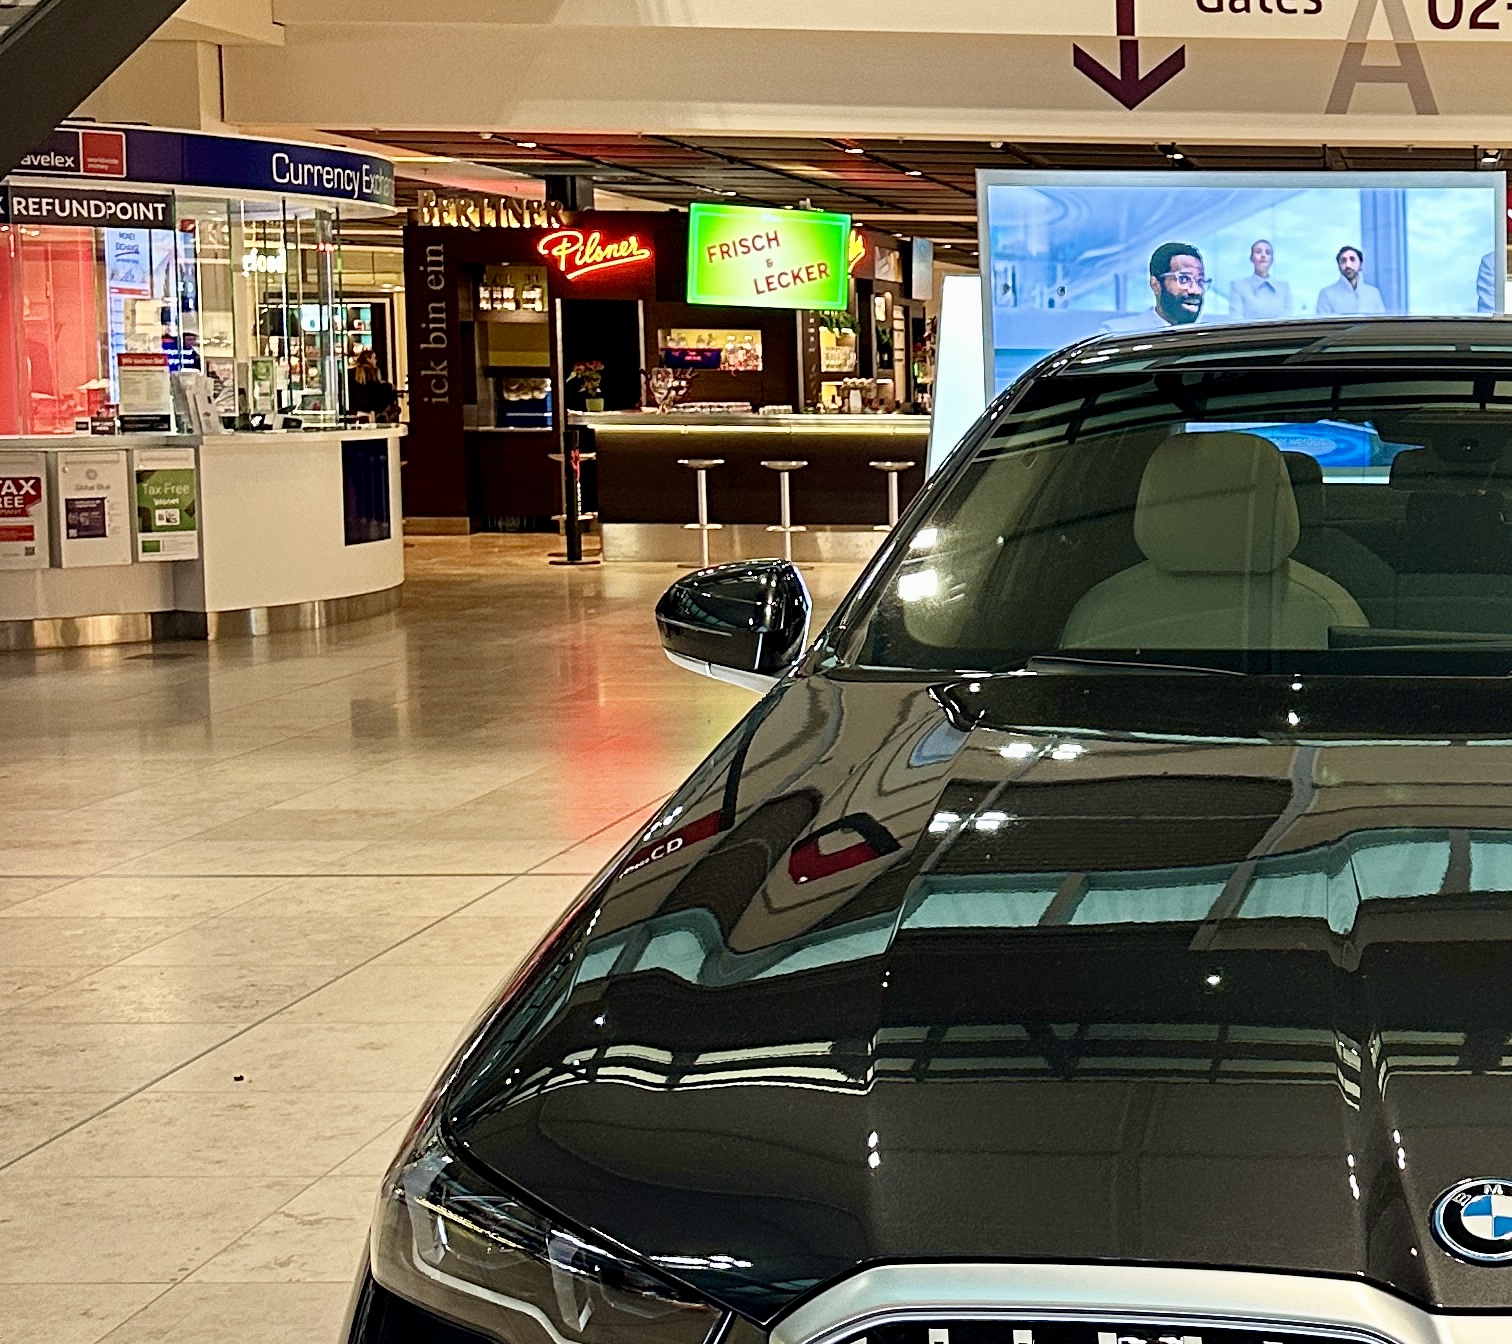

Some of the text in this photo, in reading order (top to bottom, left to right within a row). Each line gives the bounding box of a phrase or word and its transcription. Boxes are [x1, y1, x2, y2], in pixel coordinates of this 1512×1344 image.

[20, 151, 75, 168] avelex
[272, 153, 360, 199] Currency
[538, 230, 651, 280] Pilsner
[706, 230, 781, 263] FRISCH
[753, 262, 831, 295] LECKER
[419, 243, 449, 404] ick bin ein
[164, 482, 190, 495] Free
